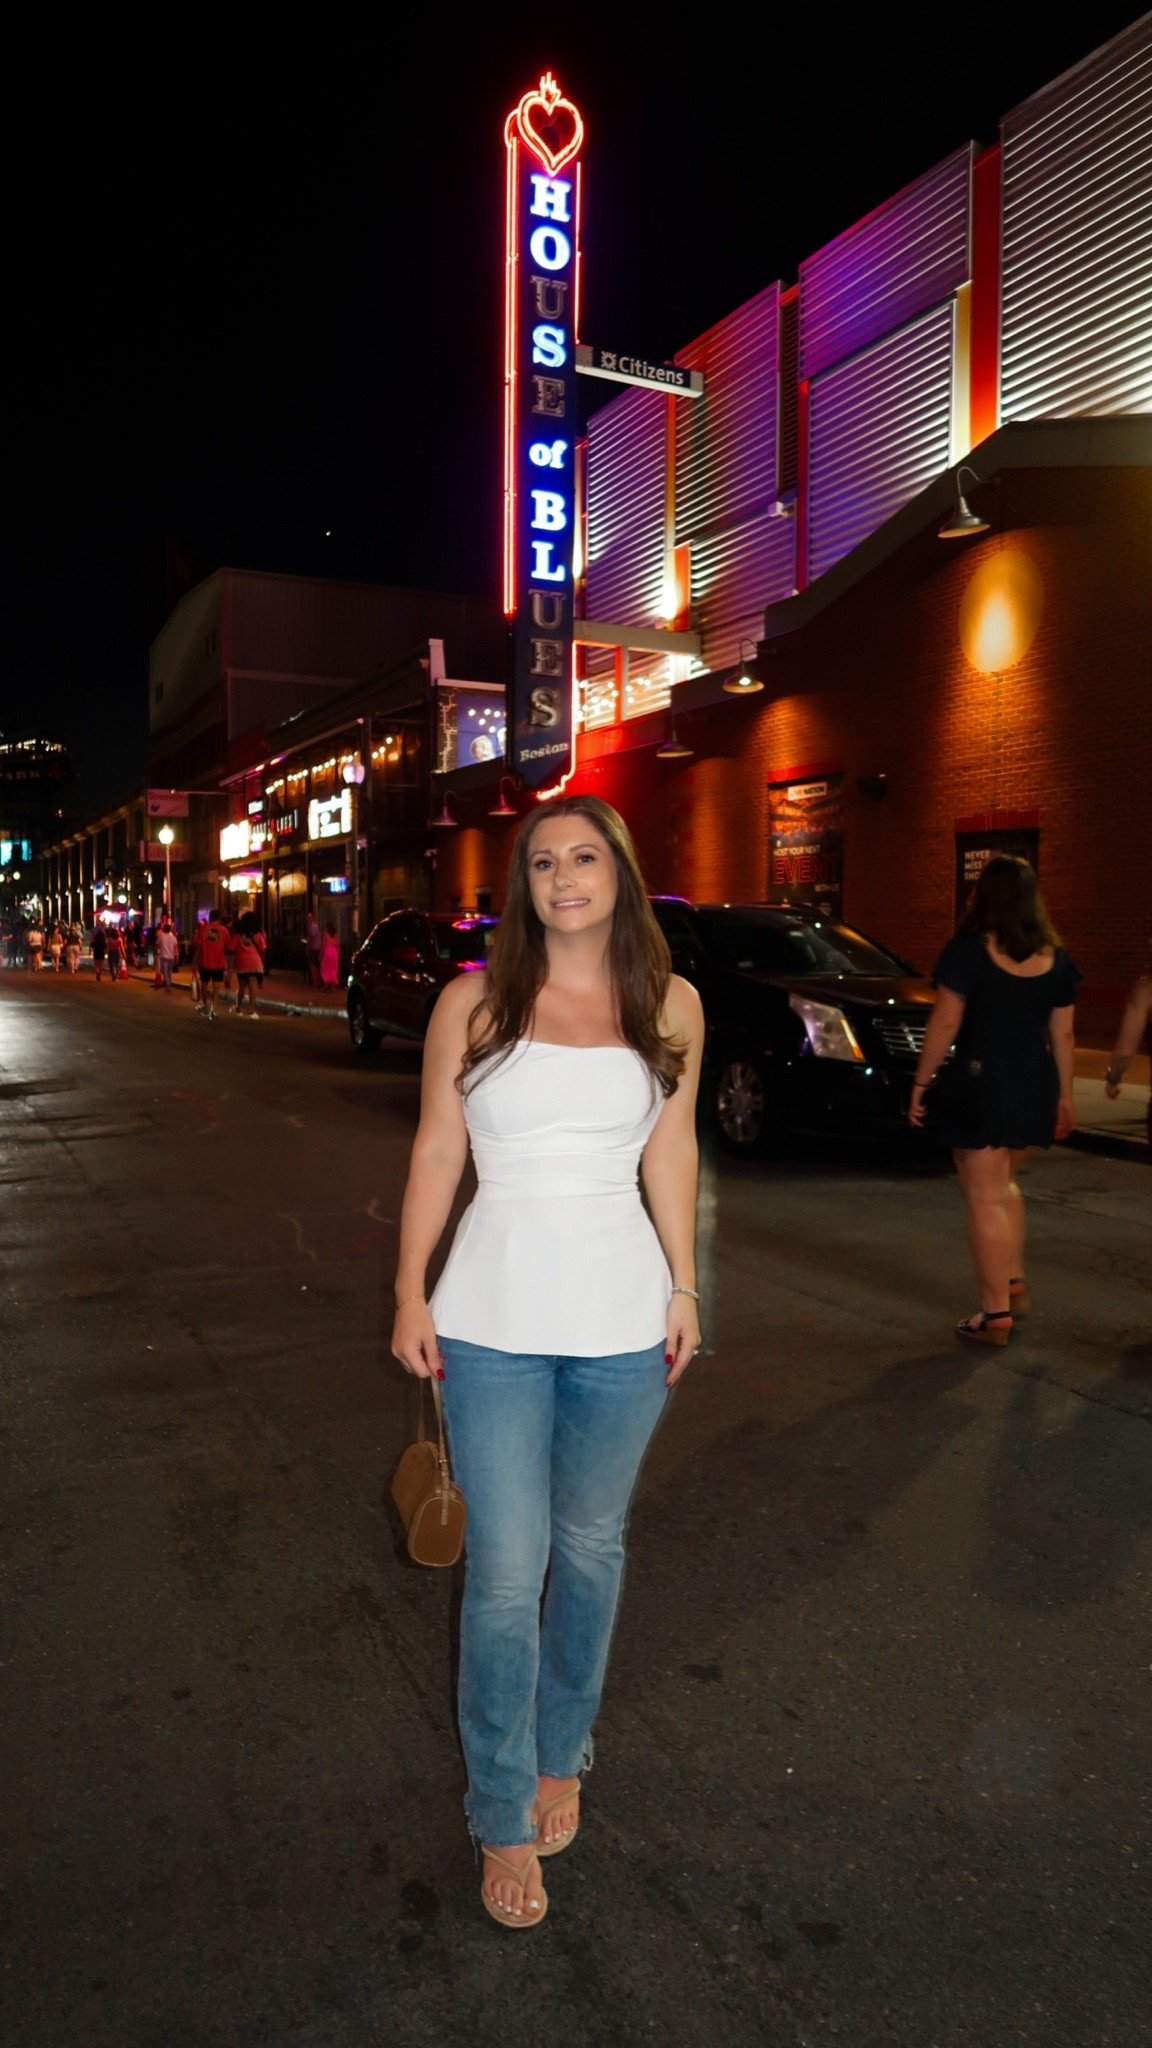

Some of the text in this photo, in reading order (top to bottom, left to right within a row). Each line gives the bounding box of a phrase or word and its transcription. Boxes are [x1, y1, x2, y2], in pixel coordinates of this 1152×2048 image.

[618, 356, 685, 386] Citizens
[528, 174, 571, 728] HOUSE of BLUES
[519, 743, 569, 762] Boston
[803, 786, 824, 795] NATION
[773, 844, 821, 857] HOST YOUR NEXT
[964, 849, 990, 860] NEVER
[773, 854, 840, 885] EVENT
[964, 861, 982, 870] MISS
